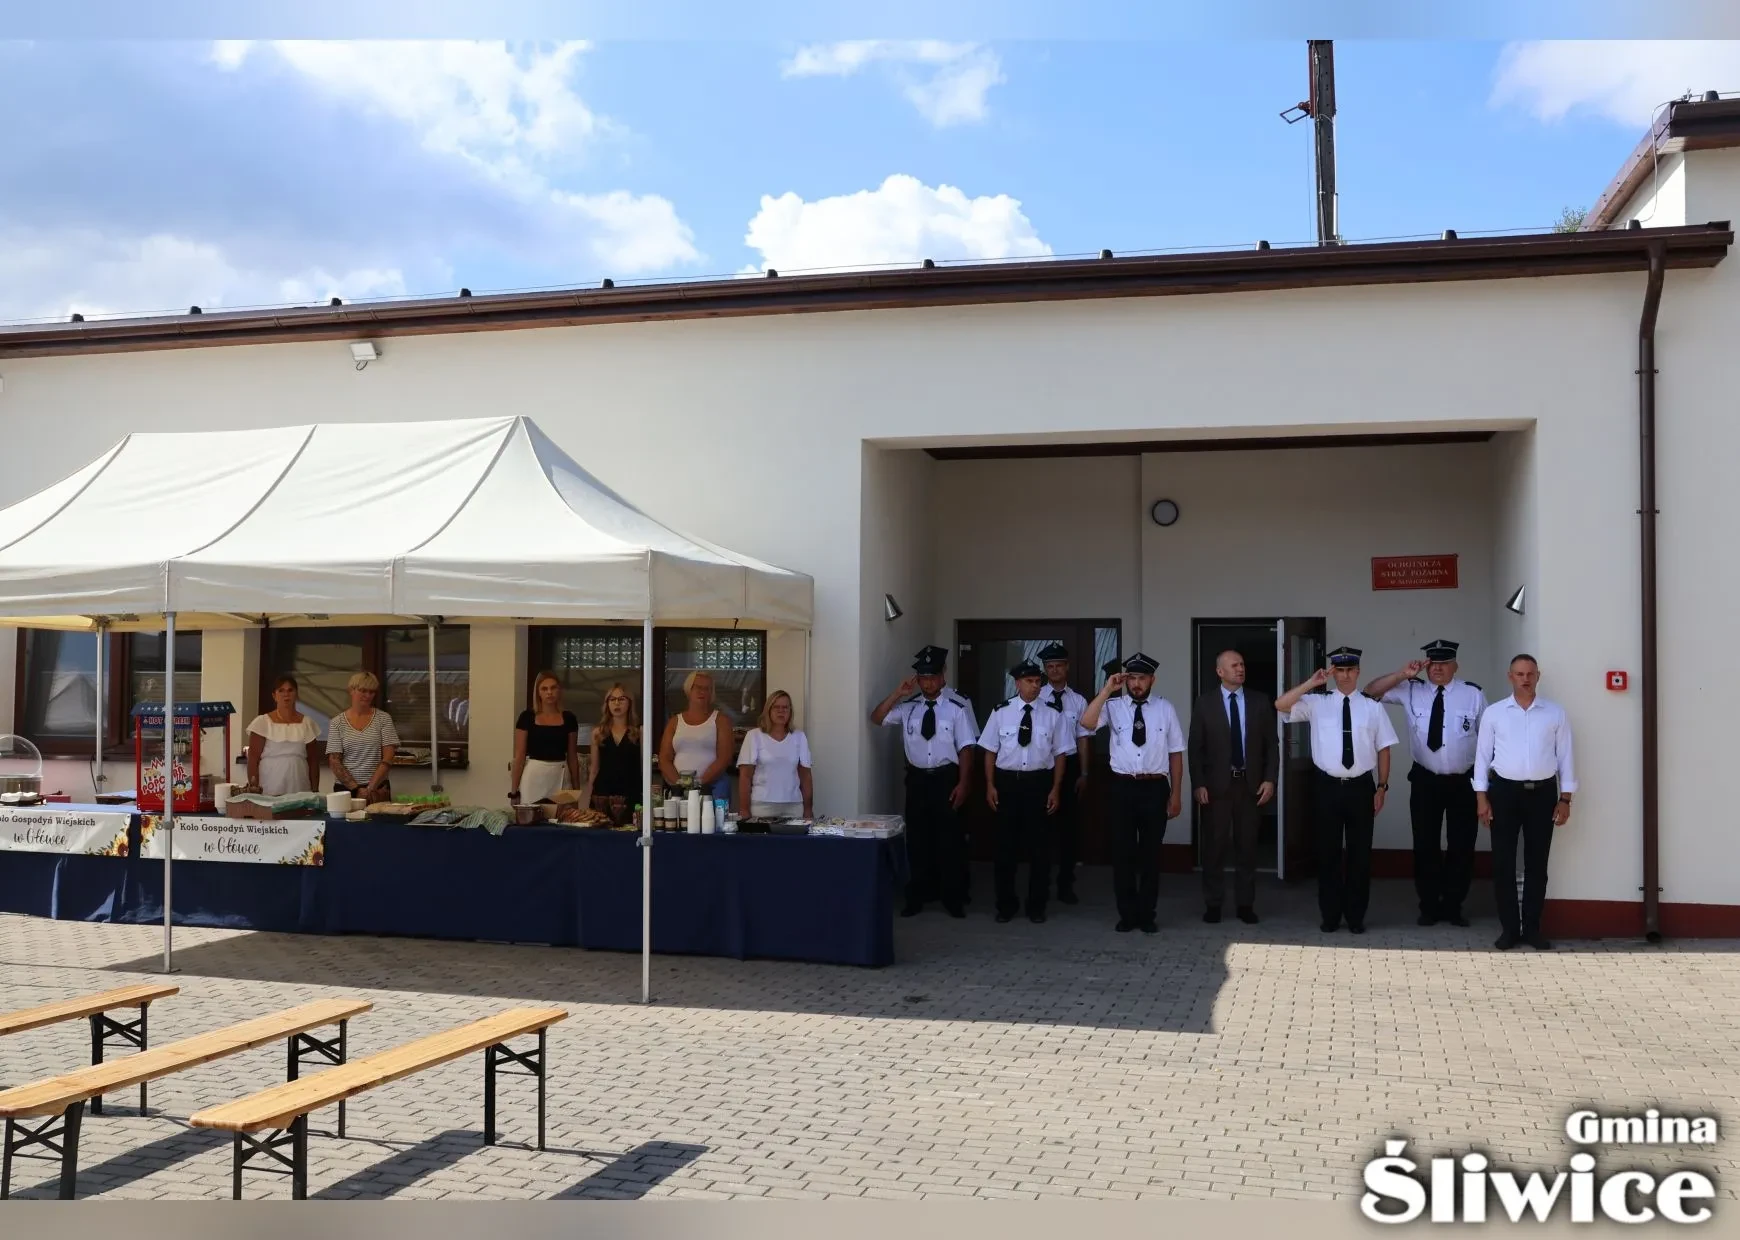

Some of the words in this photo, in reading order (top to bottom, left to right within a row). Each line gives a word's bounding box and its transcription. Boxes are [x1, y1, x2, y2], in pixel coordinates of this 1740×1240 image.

[12, 815, 53, 826] Gospodyń
[55, 816, 96, 827] Wiejskich
[13, 832, 25, 844] w
[26, 828, 67, 846] Główce
[201, 823, 244, 834] Gospodyń
[246, 824, 289, 836] Wiejskich
[204, 842, 215, 853] w
[217, 836, 261, 855] Główce
